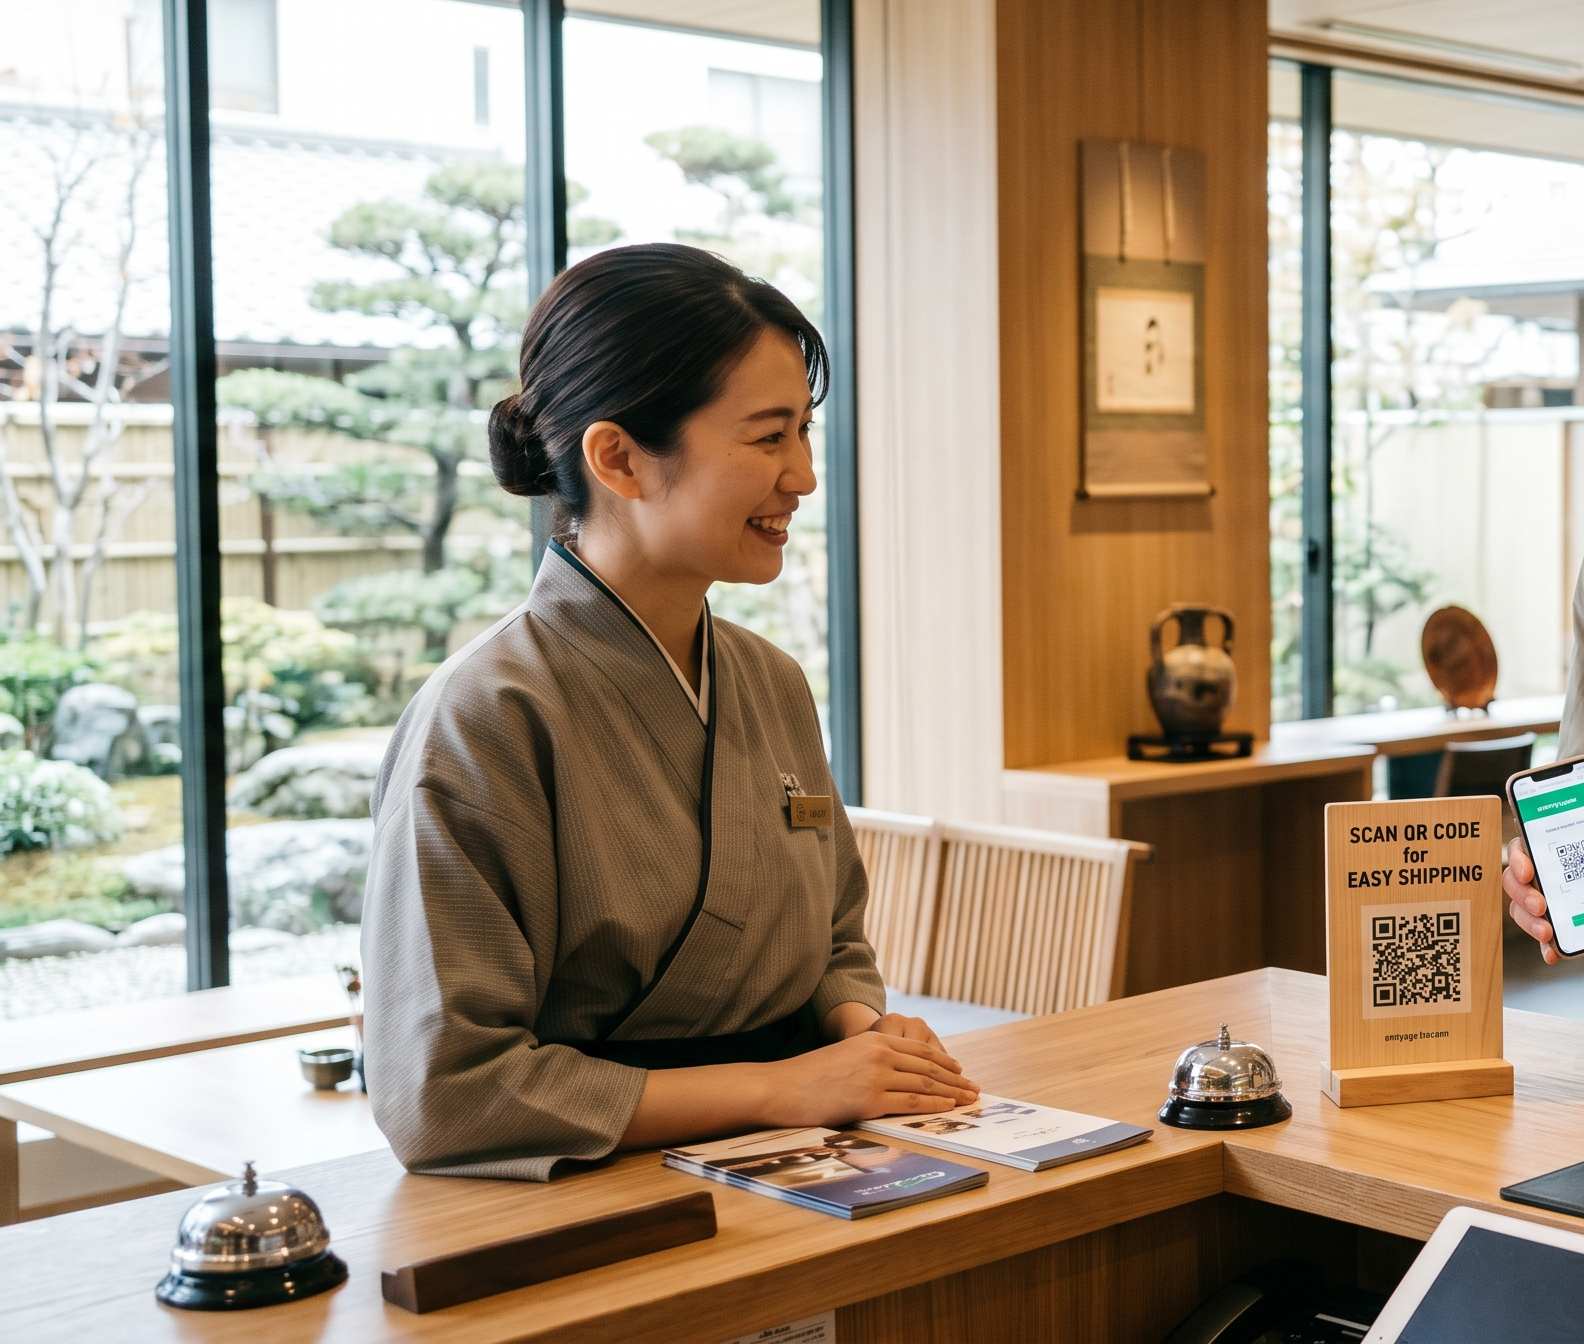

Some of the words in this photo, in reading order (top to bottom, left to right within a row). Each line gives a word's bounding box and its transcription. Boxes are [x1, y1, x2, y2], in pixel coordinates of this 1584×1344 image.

[1350, 826, 1398, 843] SCAN
[1404, 824, 1427, 841] QR
[1433, 822, 1481, 839] CODE
[1403, 847, 1428, 863] for
[1348, 870, 1393, 888] EASY
[1398, 865, 1483, 886] SHIPPING
